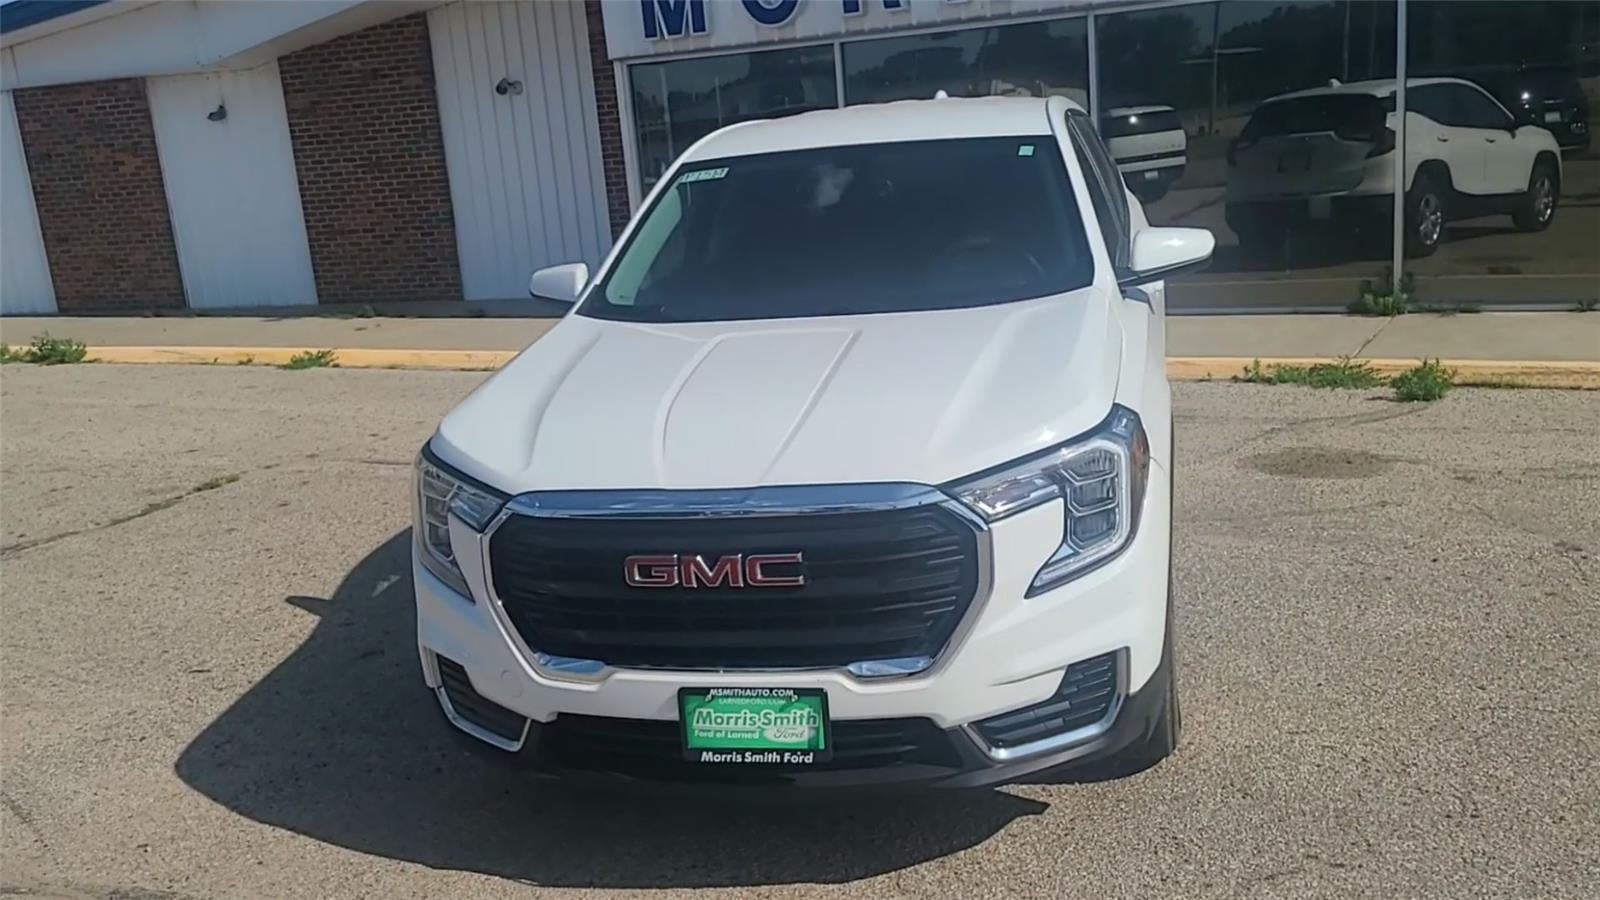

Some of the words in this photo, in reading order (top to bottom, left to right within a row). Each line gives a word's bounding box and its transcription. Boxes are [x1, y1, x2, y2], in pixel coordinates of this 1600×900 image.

[624, 552, 804, 588] GMC
[710, 689, 794, 697] MSMITHAUTO.COM
[695, 708, 759, 727] Morris
[760, 708, 818, 727] Smith
[695, 730, 714, 738] Ford
[715, 730, 725, 738] of
[773, 727, 806, 739] Ford
[700, 751, 742, 763] Morris
[744, 751, 781, 763] Smith
[783, 752, 814, 764] Ford
